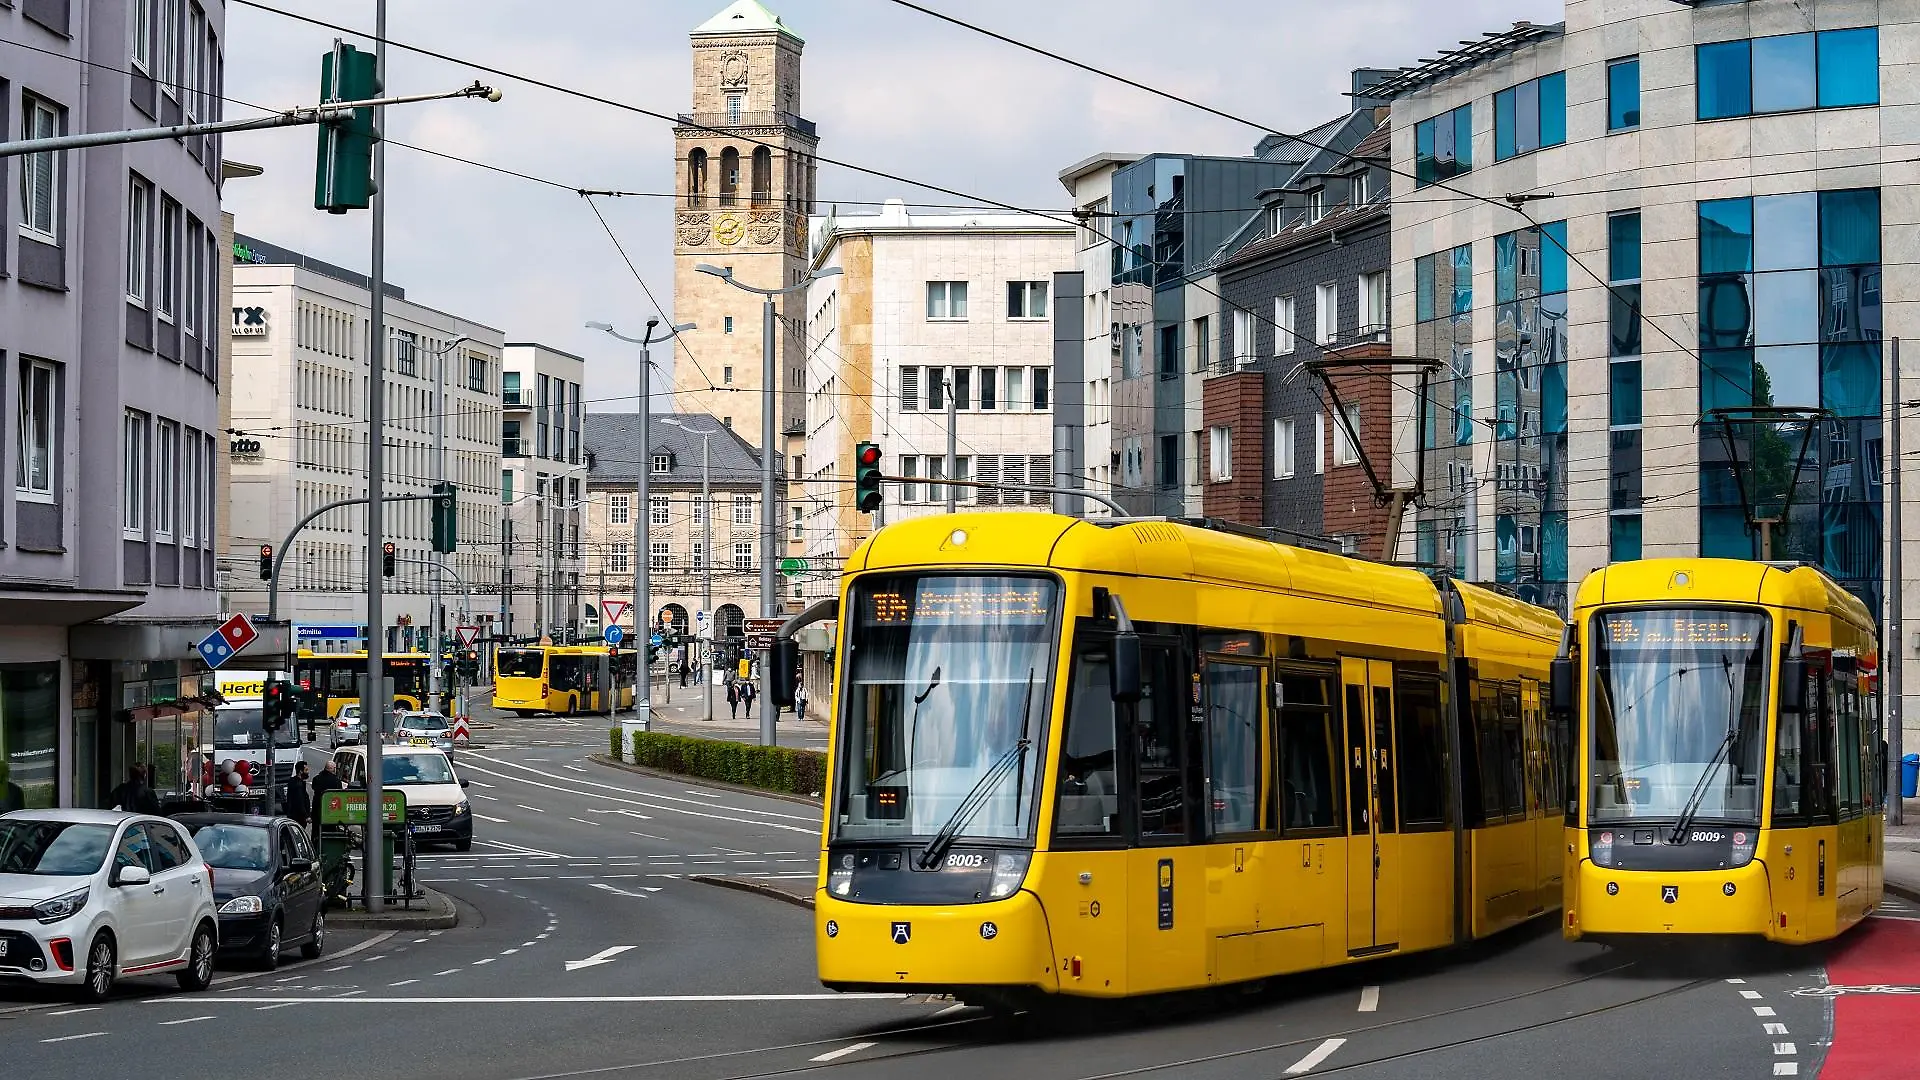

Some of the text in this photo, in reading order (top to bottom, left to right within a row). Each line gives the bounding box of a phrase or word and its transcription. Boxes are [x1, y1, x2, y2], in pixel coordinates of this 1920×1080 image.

[232, 306, 265, 325] TX
[231, 439, 260, 452] etto
[1691, 831, 1720, 842] 8009
[947, 854, 982, 867] 8003
[1063, 958, 1069, 971] 2
